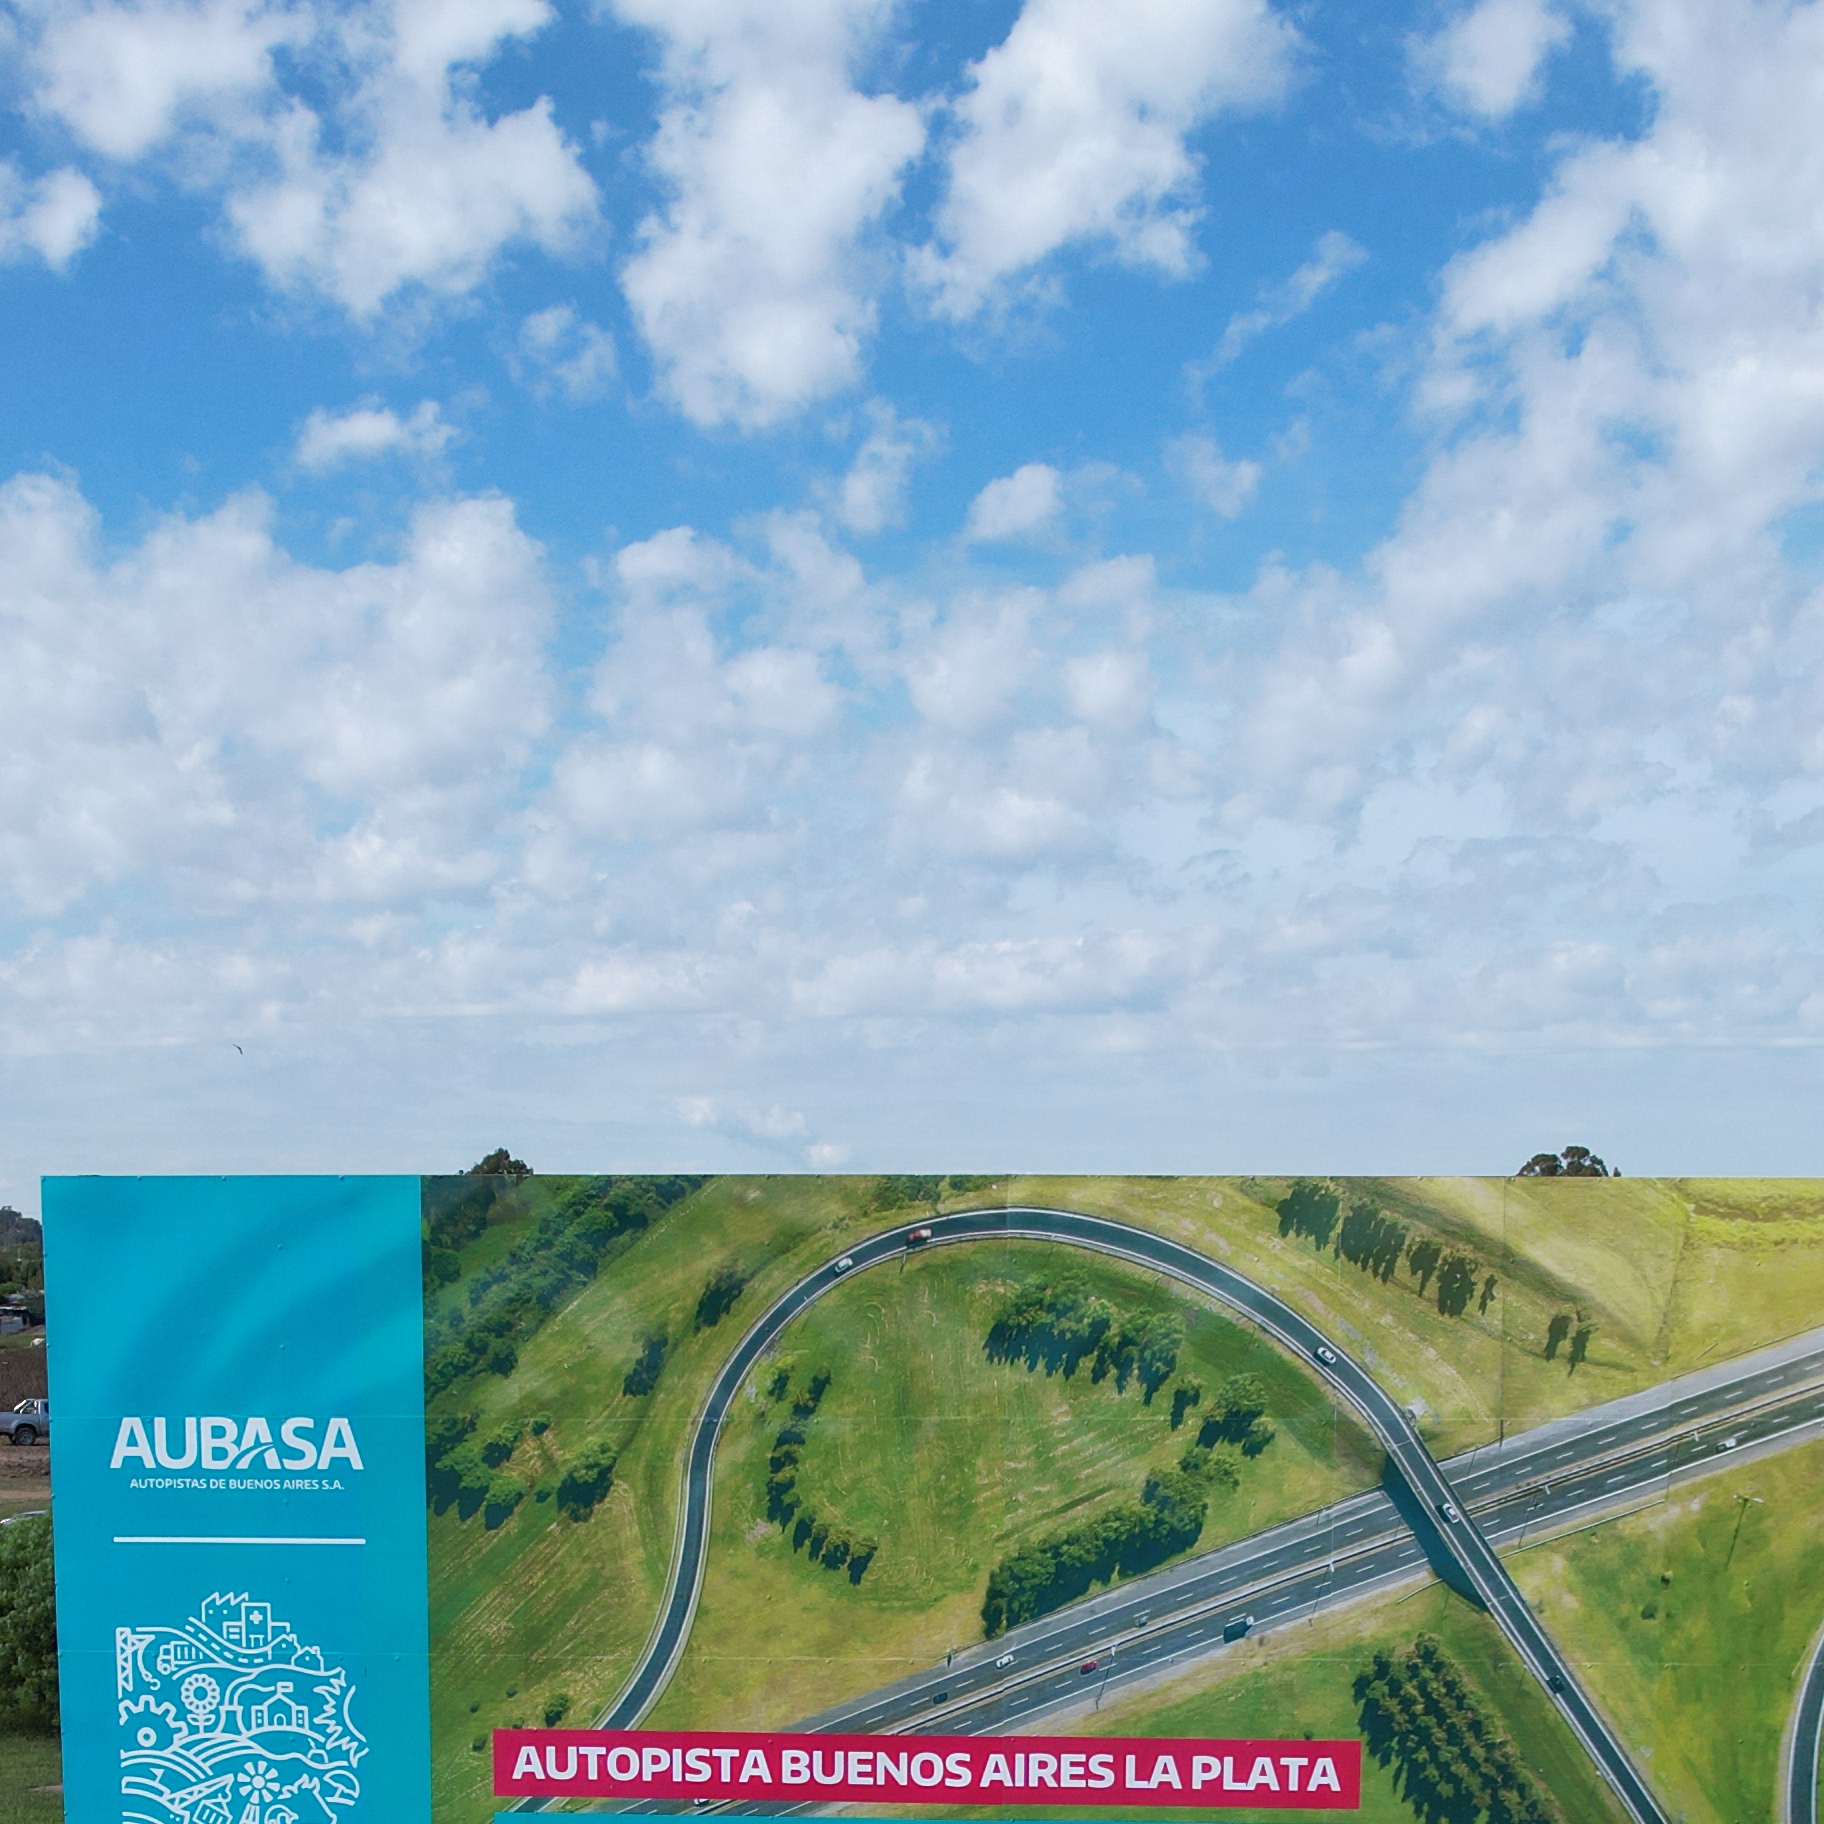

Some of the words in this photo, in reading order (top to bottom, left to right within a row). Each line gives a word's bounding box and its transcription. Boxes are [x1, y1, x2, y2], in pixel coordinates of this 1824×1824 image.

[110, 1417, 363, 1470] AUBASA
[130, 1479, 207, 1488] AUTOPISTAS
[210, 1479, 225, 1488] DE
[229, 1479, 280, 1489] BUENOS
[284, 1480, 319, 1489] AIRES
[322, 1480, 344, 1489] S.A.
[512, 1746, 772, 1783] AUTOPISTA
[782, 1750, 971, 1787] BUENOS
[980, 1754, 1114, 1788] AIRES
[1126, 1755, 1182, 1789] LA
[1192, 1756, 1341, 1791] PLATA
